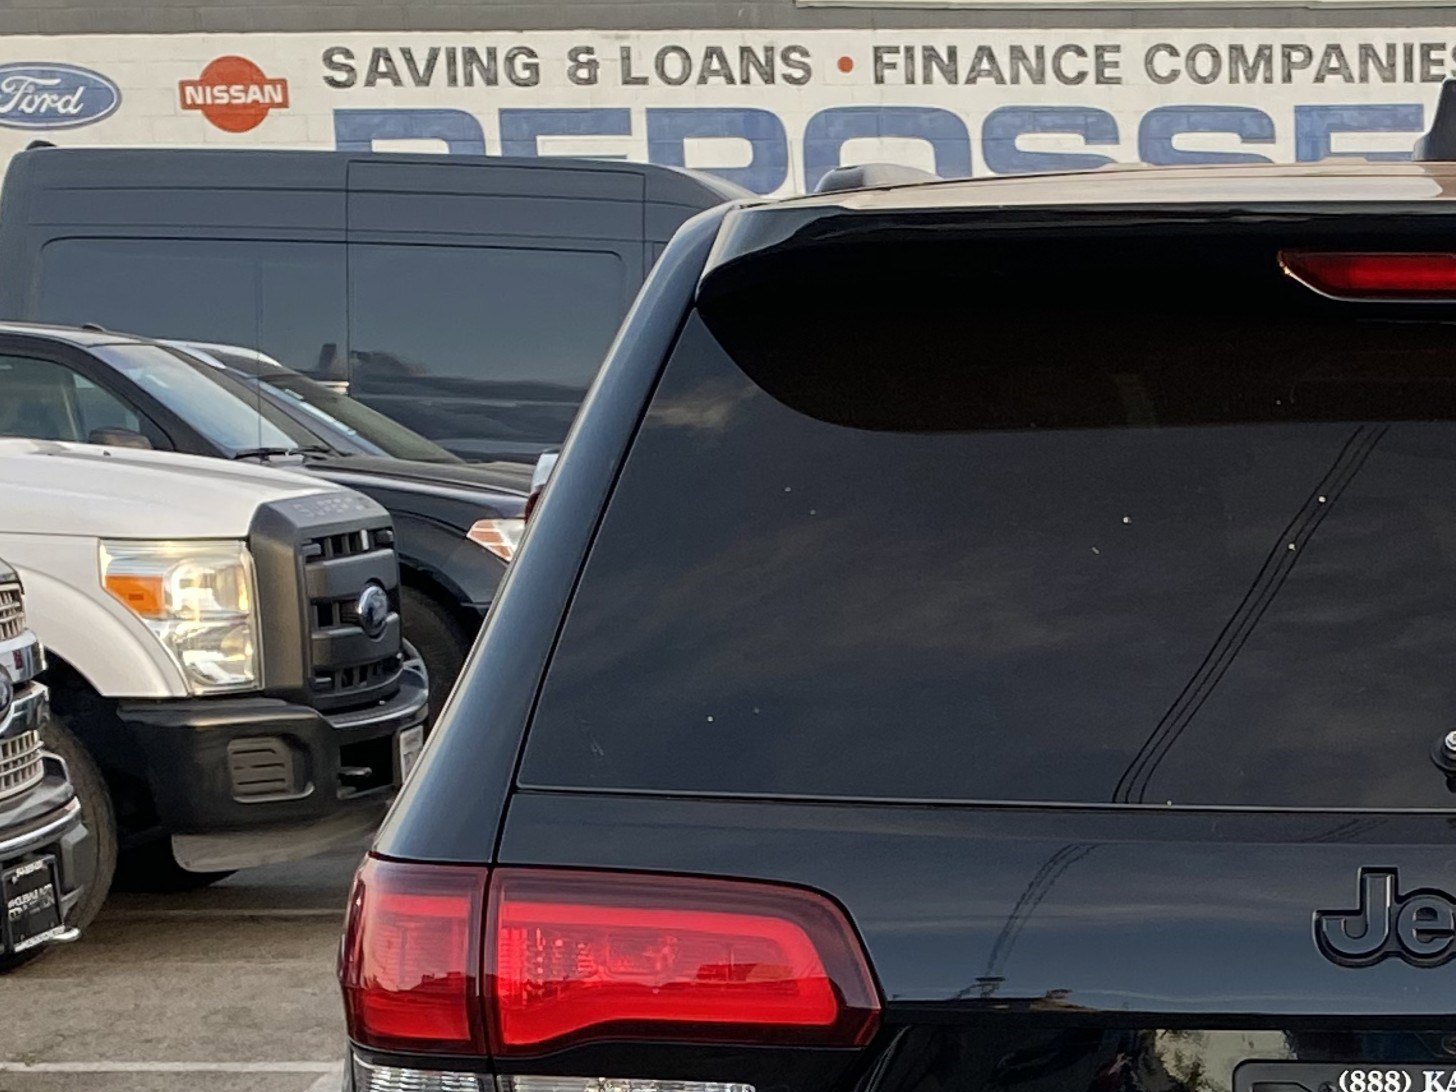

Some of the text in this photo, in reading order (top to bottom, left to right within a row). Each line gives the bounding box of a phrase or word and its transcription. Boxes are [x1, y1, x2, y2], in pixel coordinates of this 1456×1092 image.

[322, 46, 540, 88] SAVING
[567, 46, 600, 86] &
[620, 45, 812, 86] LOANS
[873, 44, 1122, 85] FINANCE
[0, 75, 86, 114] Ford
[185, 82, 283, 108] NISSAN
